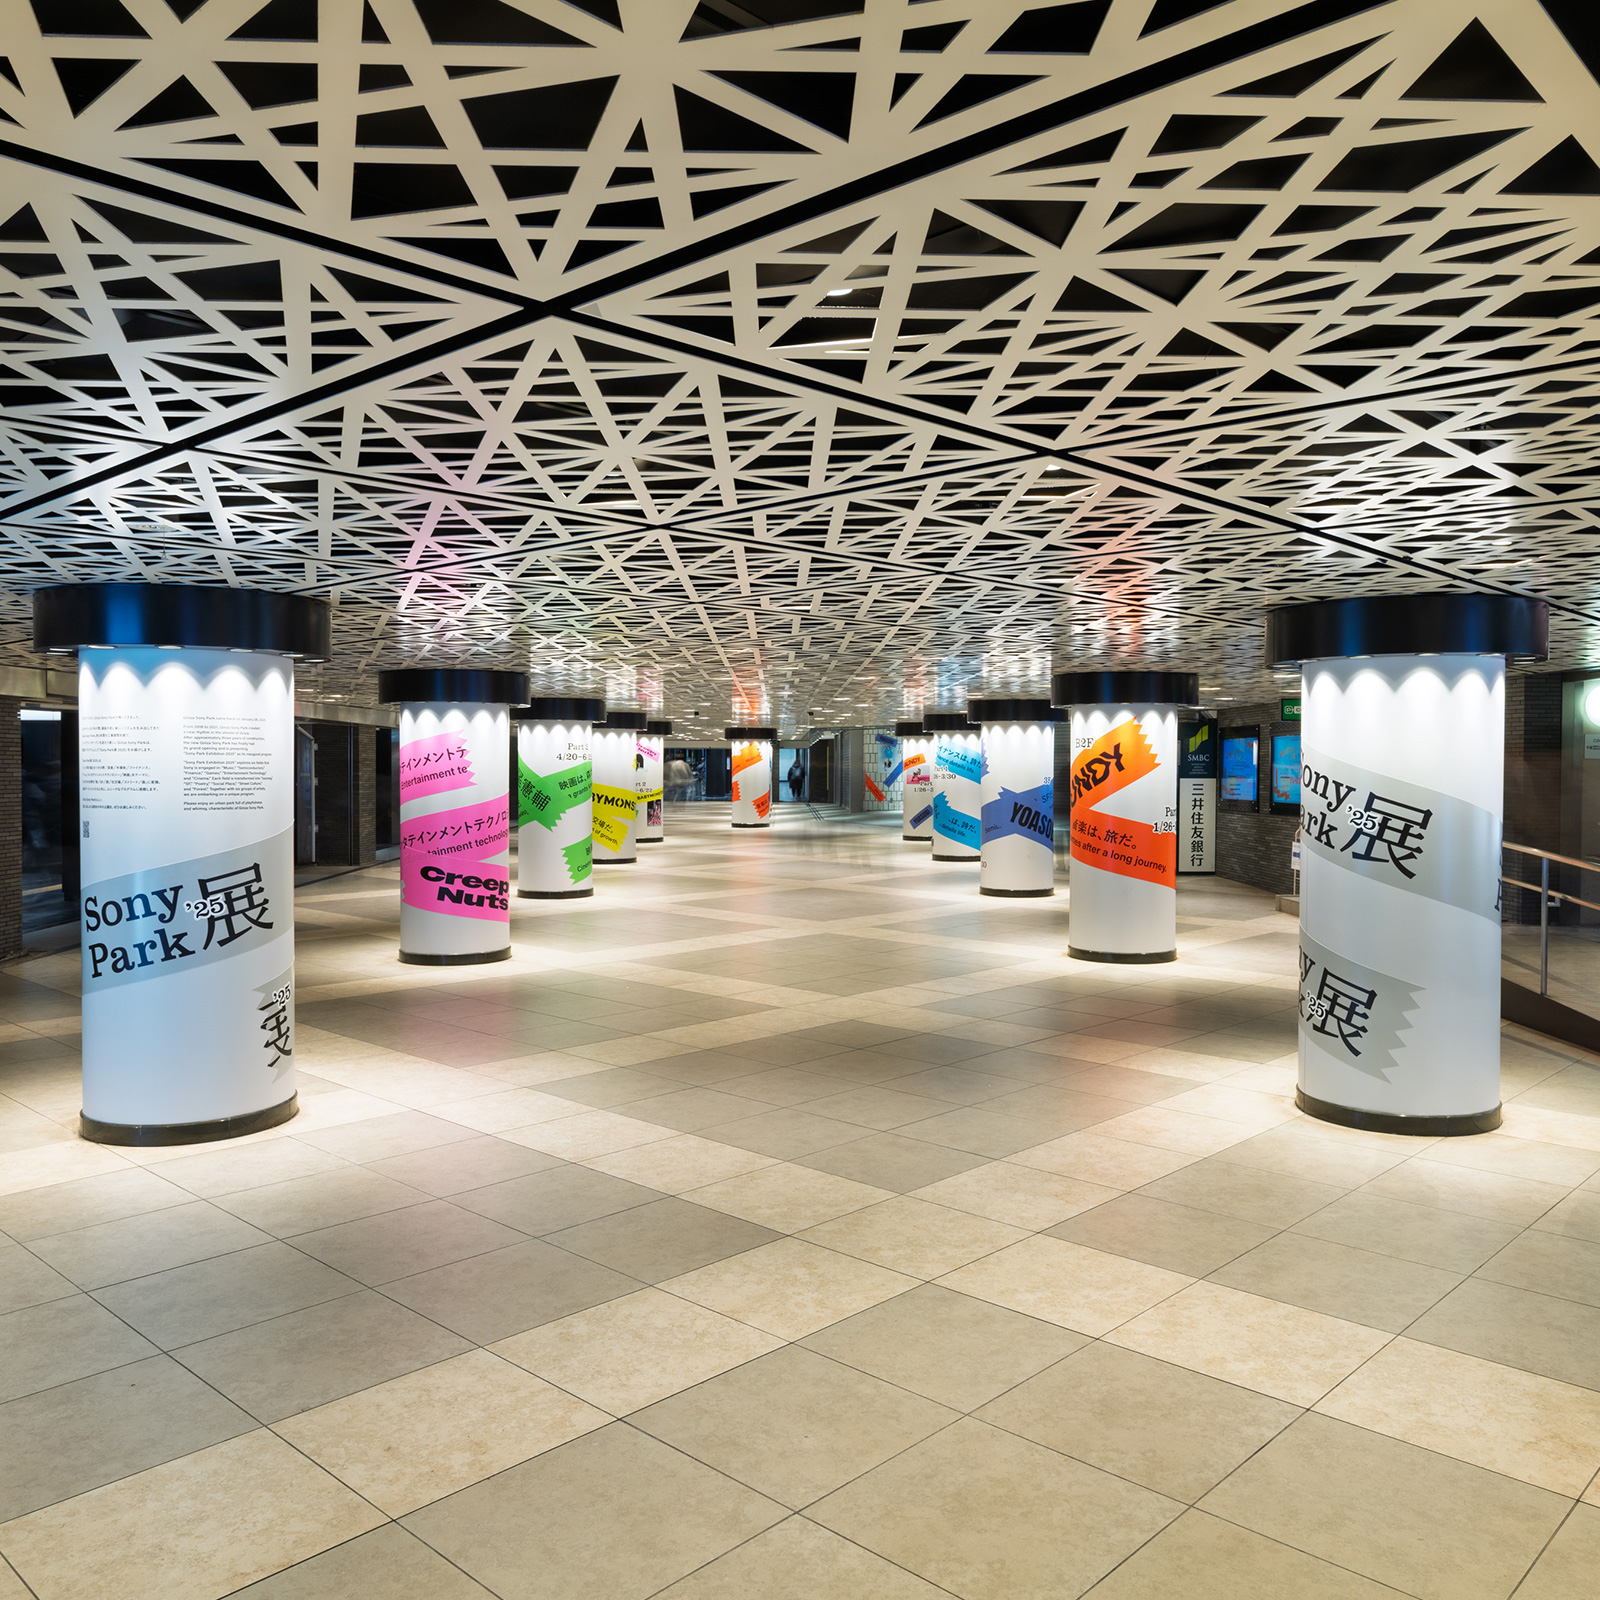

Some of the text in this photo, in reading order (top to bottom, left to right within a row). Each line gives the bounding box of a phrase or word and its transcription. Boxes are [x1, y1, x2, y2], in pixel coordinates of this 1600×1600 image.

[1076, 738, 1094, 748] B2F
[1191, 783, 1204, 866] 三井住友銀行
[1340, 791, 1432, 880] 展
[1082, 842, 1101, 856] after
[1110, 850, 1133, 866] long
[1134, 856, 1166, 874] journey.
[84, 884, 184, 932] Sony
[198, 862, 274, 951] 展
[437, 886, 508, 911] Nuts
[88, 928, 196, 979] Park
[1306, 966, 1378, 1057] 展
